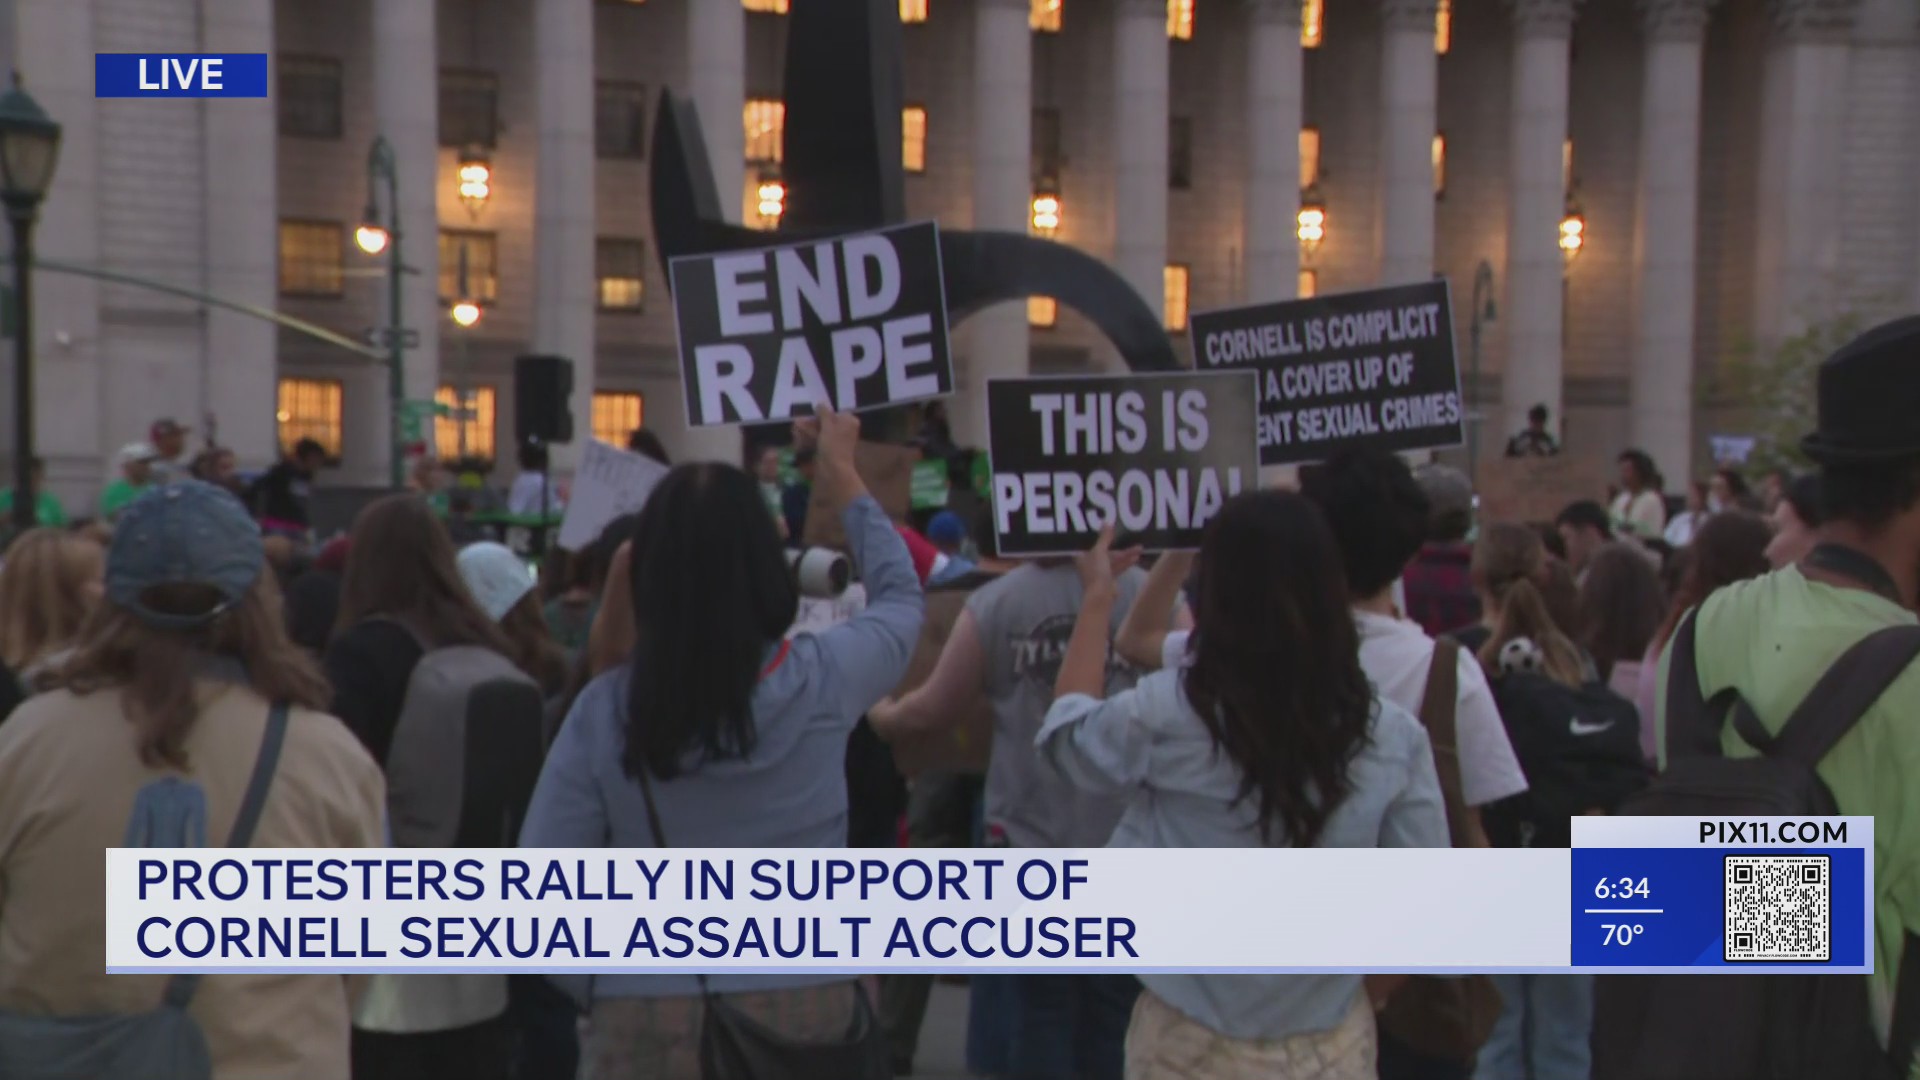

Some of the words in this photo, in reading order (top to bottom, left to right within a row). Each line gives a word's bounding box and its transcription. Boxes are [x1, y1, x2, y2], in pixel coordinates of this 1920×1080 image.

[713, 234, 901, 338] END
[1206, 321, 1303, 366] CORNELL
[1304, 318, 1326, 352] IS
[1327, 303, 1439, 349] COMPLICIT
[694, 313, 939, 425] RAPE
[1265, 369, 1281, 401] A
[1281, 360, 1353, 399] COVER
[1354, 355, 1383, 390] UP
[1386, 350, 1413, 386] OF
[1030, 390, 1148, 456] THIS
[1162, 389, 1210, 452] IS
[1296, 402, 1379, 442] SEXUAL
[1381, 391, 1460, 433] CRIMES
